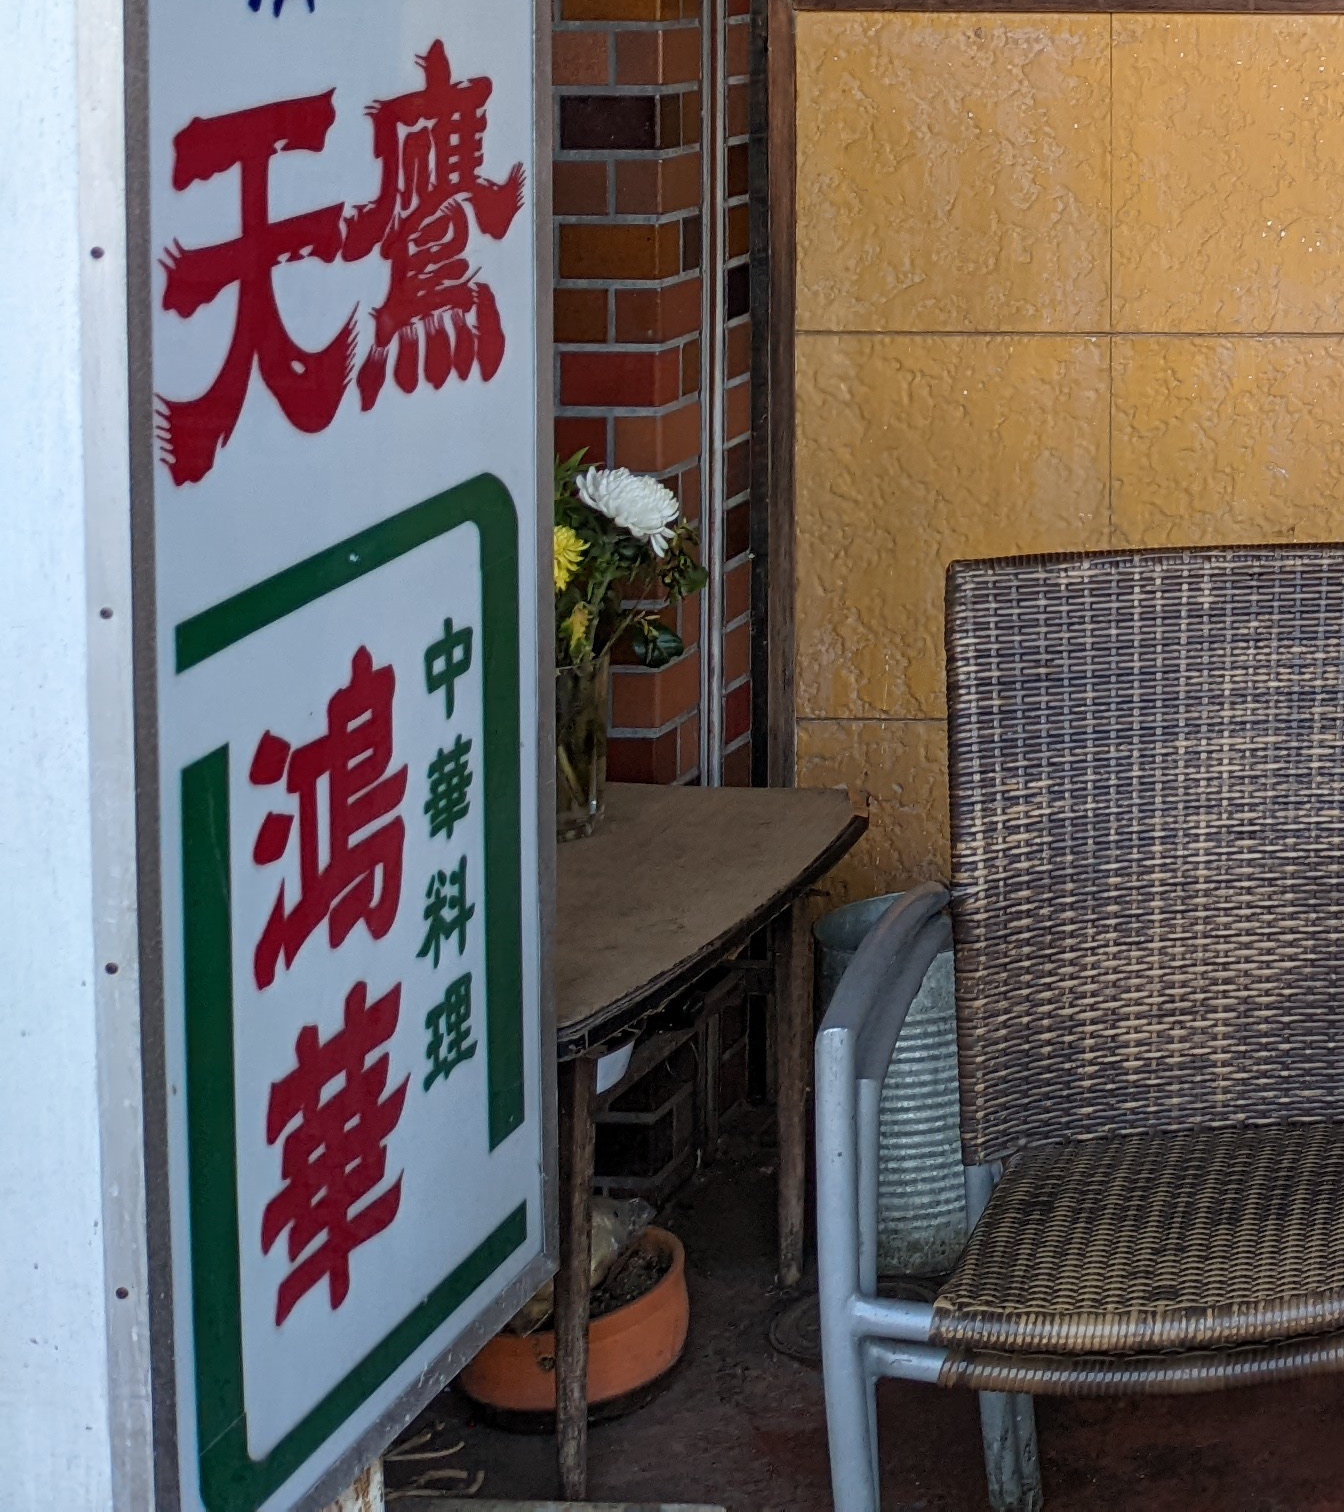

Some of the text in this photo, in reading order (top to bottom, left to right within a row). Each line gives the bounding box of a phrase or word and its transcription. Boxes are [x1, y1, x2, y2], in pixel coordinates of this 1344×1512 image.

[153, 39, 526, 486] 天鷹
[249, 644, 411, 1327] 鴻華
[416, 616, 479, 1093] 中華料理
